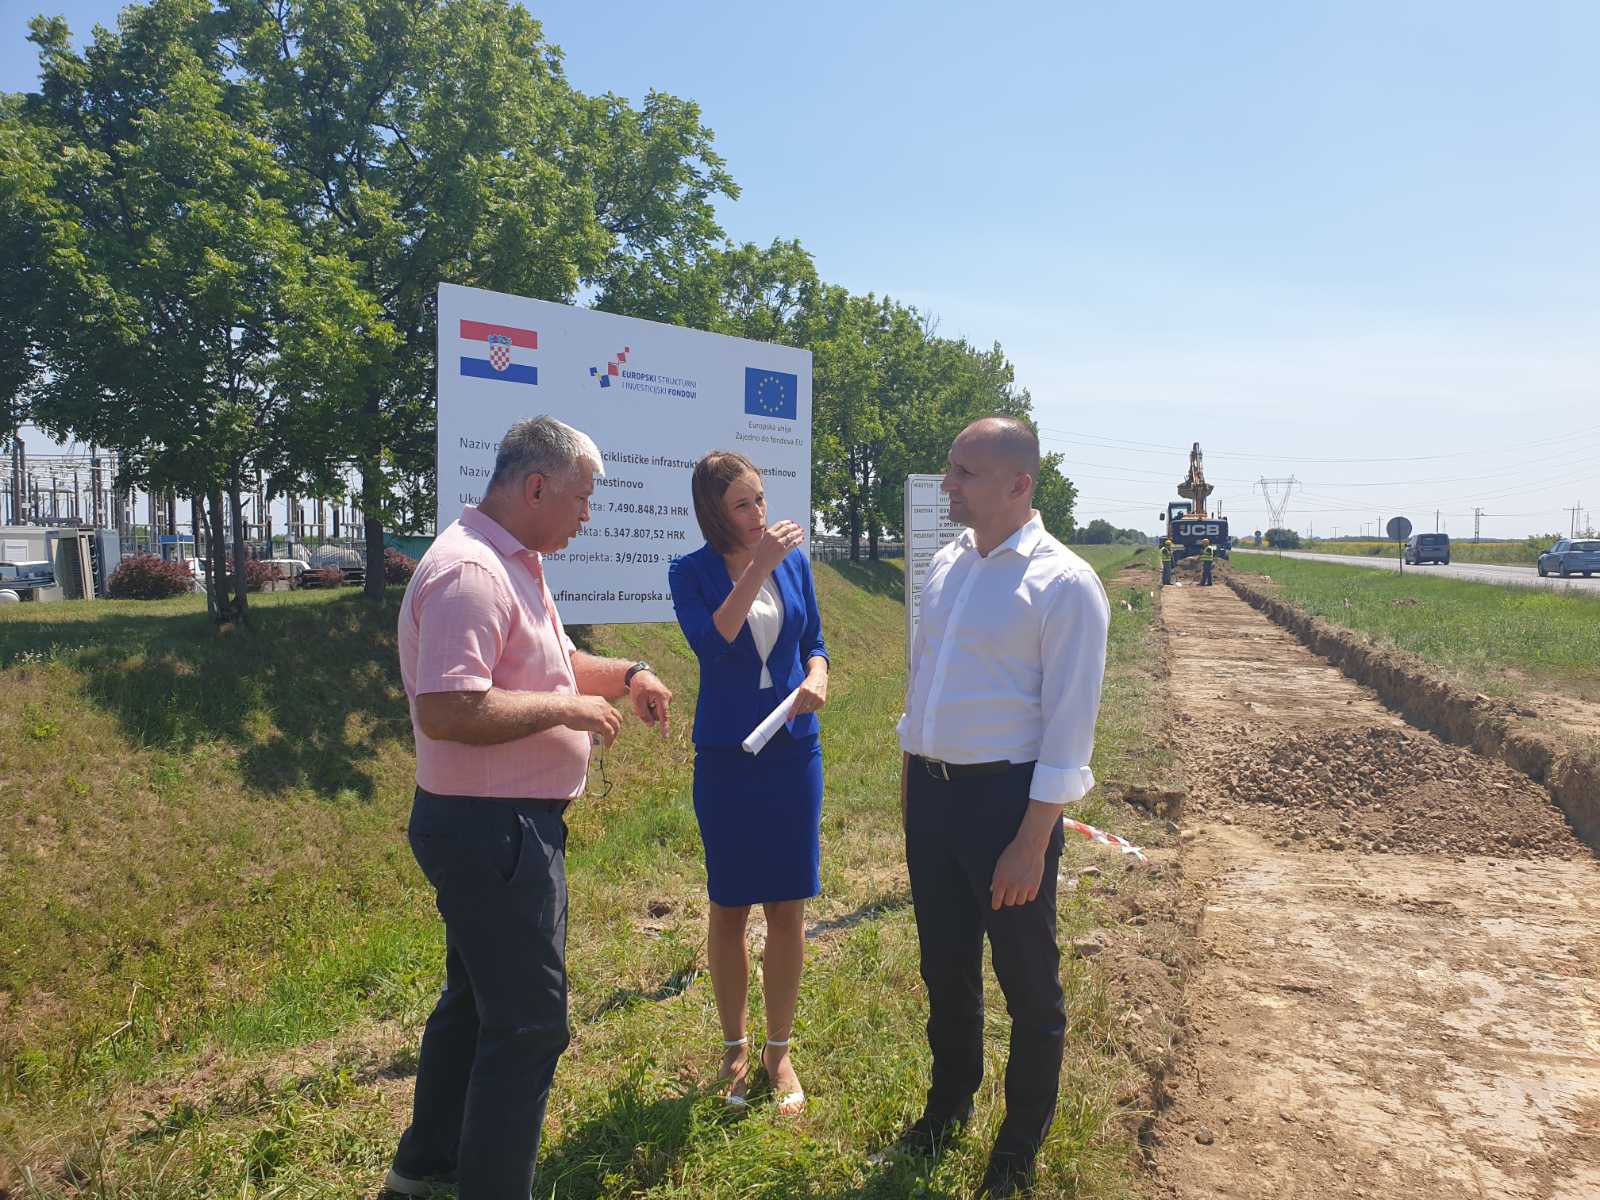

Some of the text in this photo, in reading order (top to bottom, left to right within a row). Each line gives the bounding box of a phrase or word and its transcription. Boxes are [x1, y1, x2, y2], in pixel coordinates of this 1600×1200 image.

[622, 370, 697, 389] EUROPSKI STRUKTURNI
[668, 388, 697, 399] FONDOVI
[460, 437, 490, 450] Naziv
[600, 450, 650, 465] iciklističke
[760, 468, 797, 478] nestinovo
[460, 465, 490, 478] Naziv
[592, 477, 644, 489] rnestinovo
[459, 493, 481, 505] Uku
[608, 502, 668, 516] 7.490.848,23
[671, 506, 689, 517] HRK
[604, 527, 664, 540] 6.347.807,52
[667, 530, 686, 540] HRK
[1180, 524, 1220, 536] JCB
[569, 553, 613, 565] projekta:
[615, 552, 659, 565] 3/9/2019
[553, 590, 616, 602] ufinancirala
[618, 591, 663, 604] Europska
